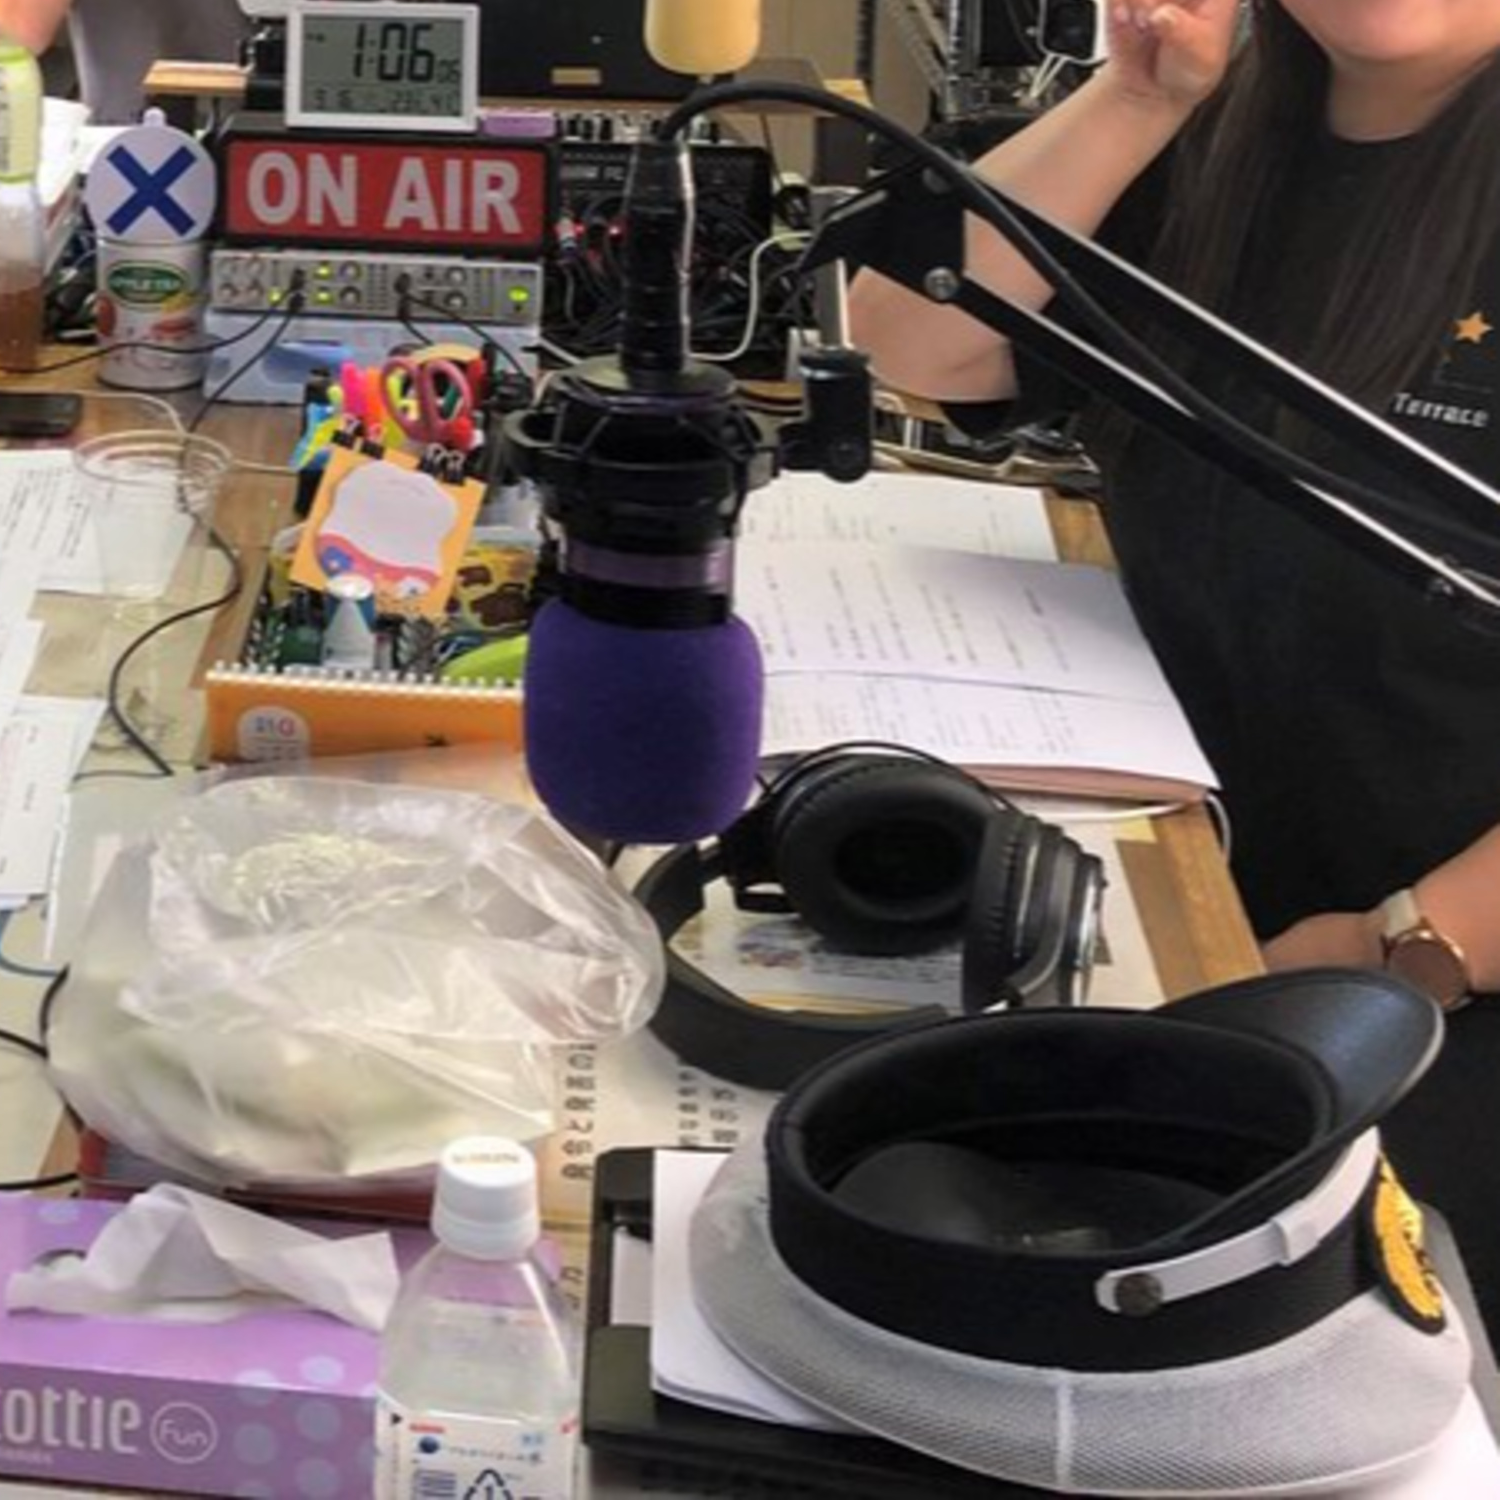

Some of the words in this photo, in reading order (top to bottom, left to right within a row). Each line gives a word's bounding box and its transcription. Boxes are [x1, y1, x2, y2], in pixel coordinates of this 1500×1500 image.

[353, 22, 435, 83] 1:06
[247, 151, 358, 228] ON
[383, 156, 523, 235] AIR
[1394, 392, 1490, 428] Terrace
[159, 1418, 209, 1448] Fun
